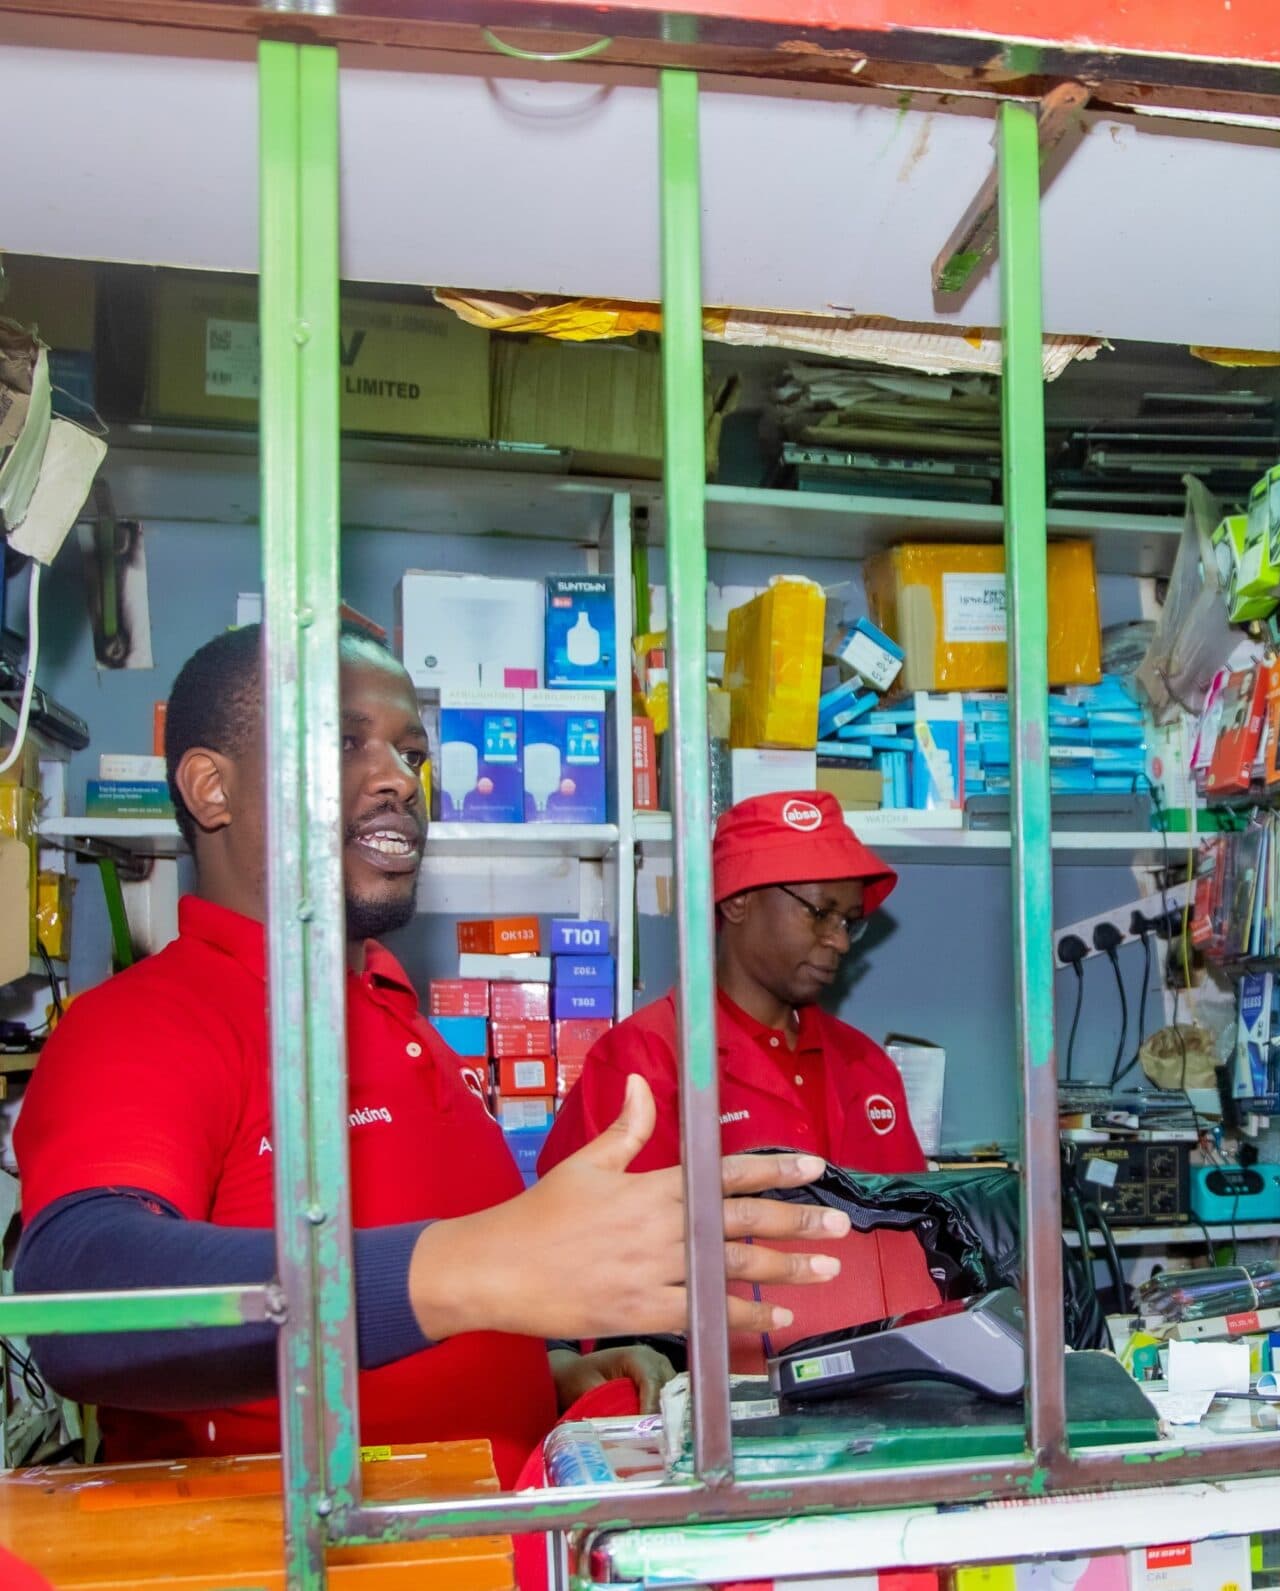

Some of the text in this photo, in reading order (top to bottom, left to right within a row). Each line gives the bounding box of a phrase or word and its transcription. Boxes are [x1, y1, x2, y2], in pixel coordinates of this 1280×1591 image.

[345, 376, 421, 400] LIMITED
[557, 581, 607, 593] SUNTOWN
[787, 809, 818, 821] absa
[501, 929, 534, 942] OK133
[561, 928, 601, 945] T101
[348, 1107, 393, 1127] nking
[720, 1109, 750, 1124] shara
[869, 1106, 892, 1120] absa
